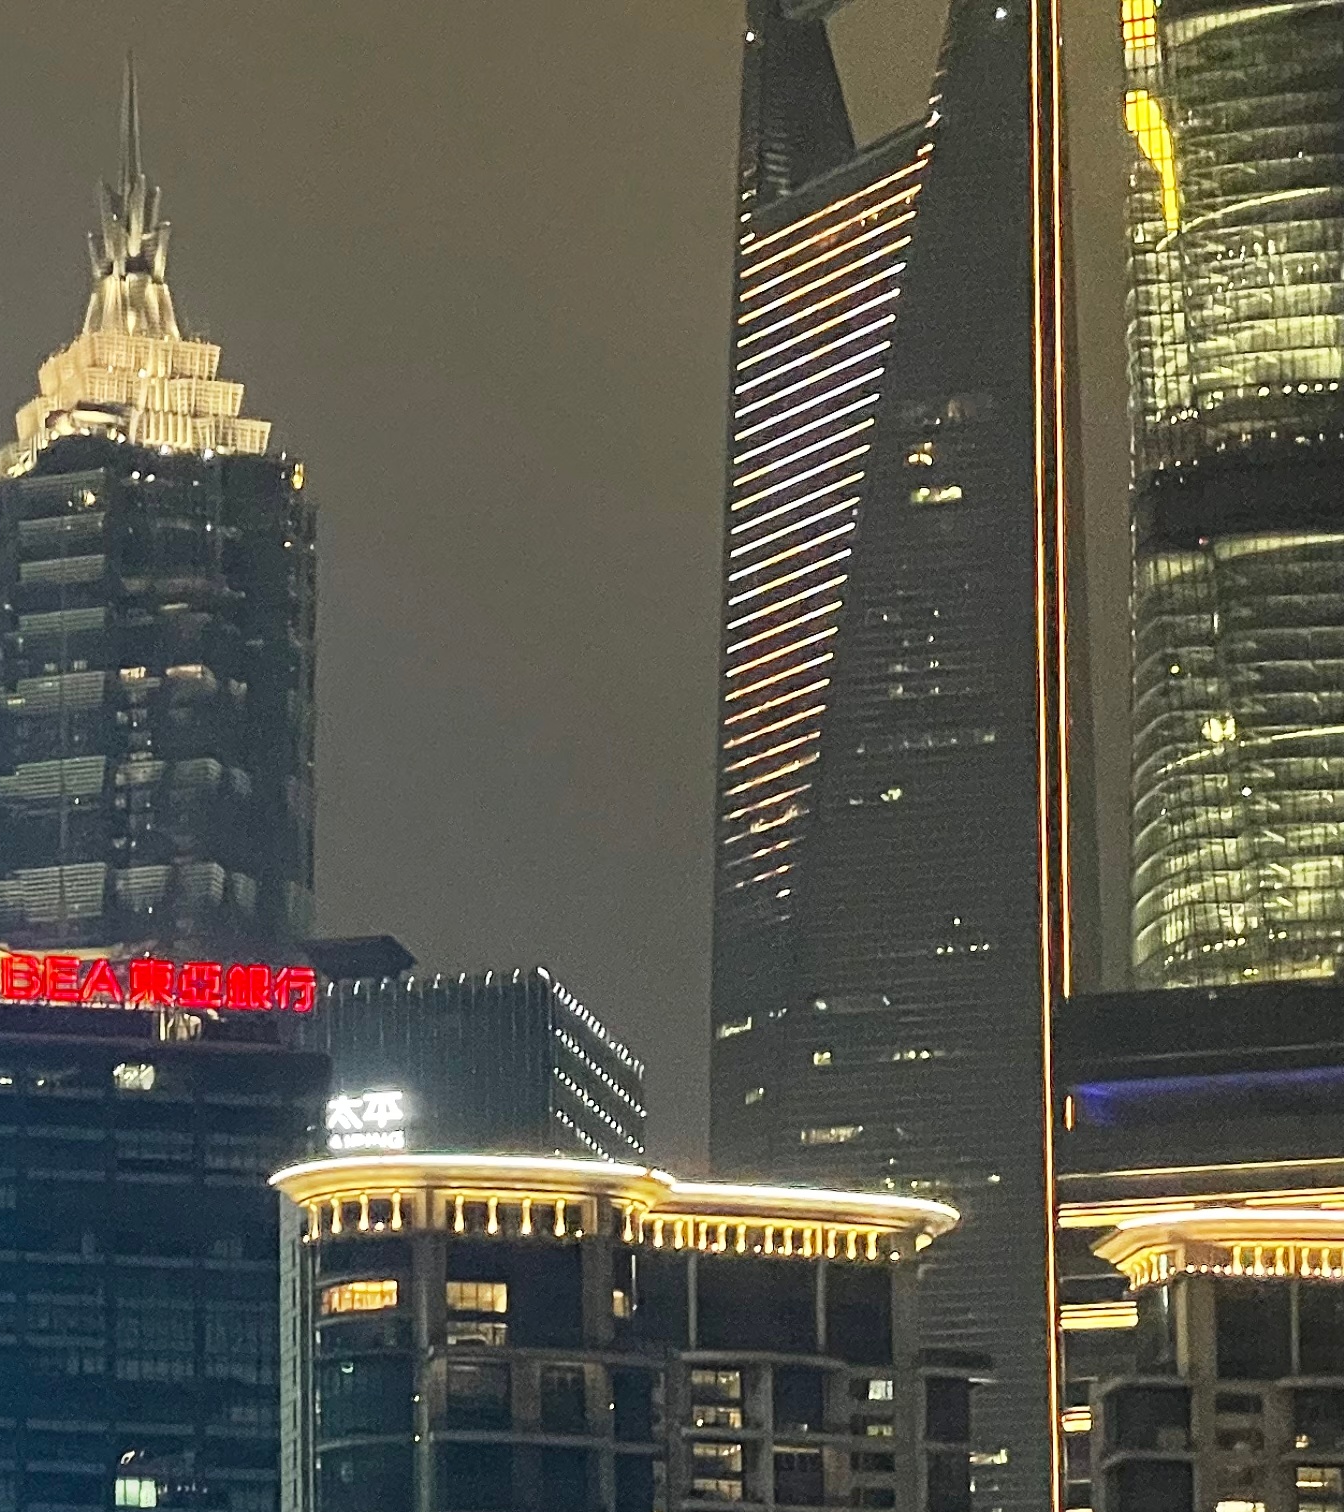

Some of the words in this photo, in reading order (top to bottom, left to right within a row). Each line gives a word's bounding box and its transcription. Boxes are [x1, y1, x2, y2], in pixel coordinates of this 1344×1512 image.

[0, 954, 123, 1003] BEA
[129, 958, 317, 1013] 東亞銀行
[327, 1090, 404, 1130] 太平
